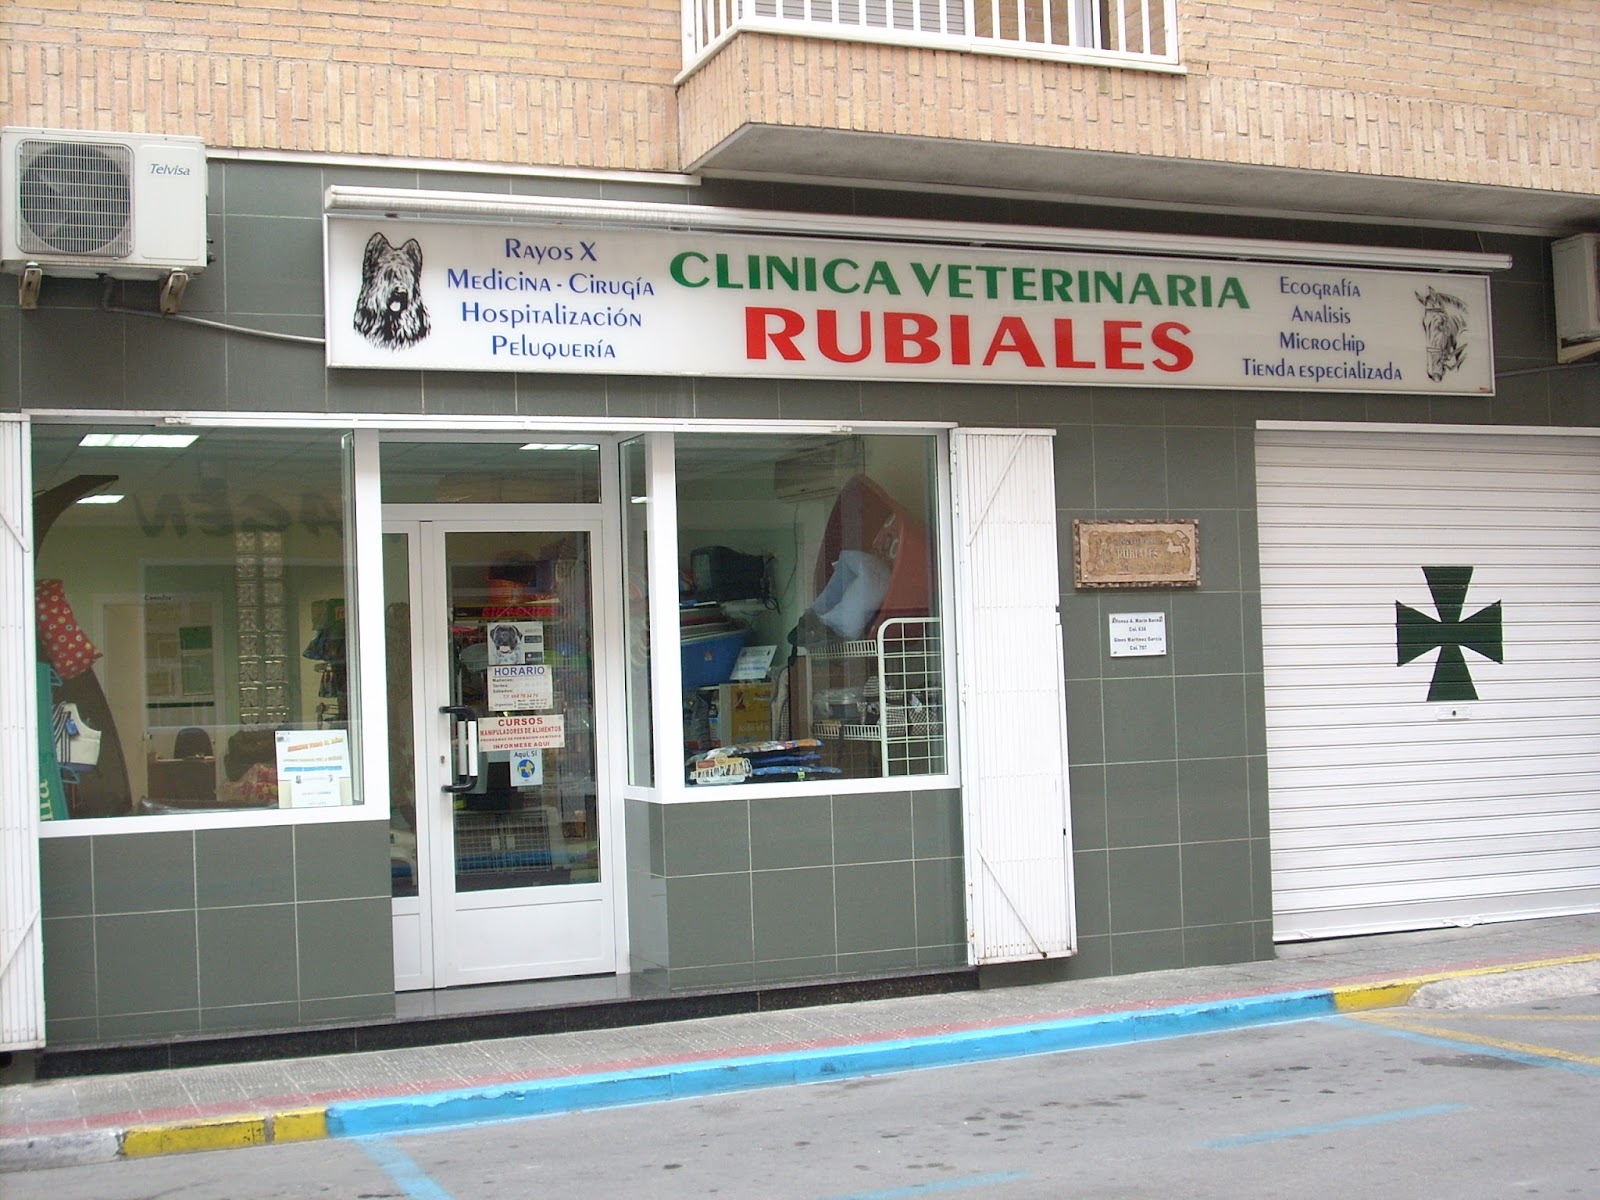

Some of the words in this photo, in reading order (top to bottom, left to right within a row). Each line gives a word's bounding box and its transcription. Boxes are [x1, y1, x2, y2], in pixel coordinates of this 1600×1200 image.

[151, 163, 191, 176] Telvisa
[580, 241, 597, 262] X
[669, 252, 901, 295] CLINICA
[910, 262, 1250, 309] VETERINARIA
[745, 306, 1194, 372] RUBIALES
[1117, 548, 1159, 560] RUBIALES
[494, 666, 545, 676] HORARIO
[498, 717, 543, 727] CURSOS
[480, 727, 524, 736] MANIPULADORES
